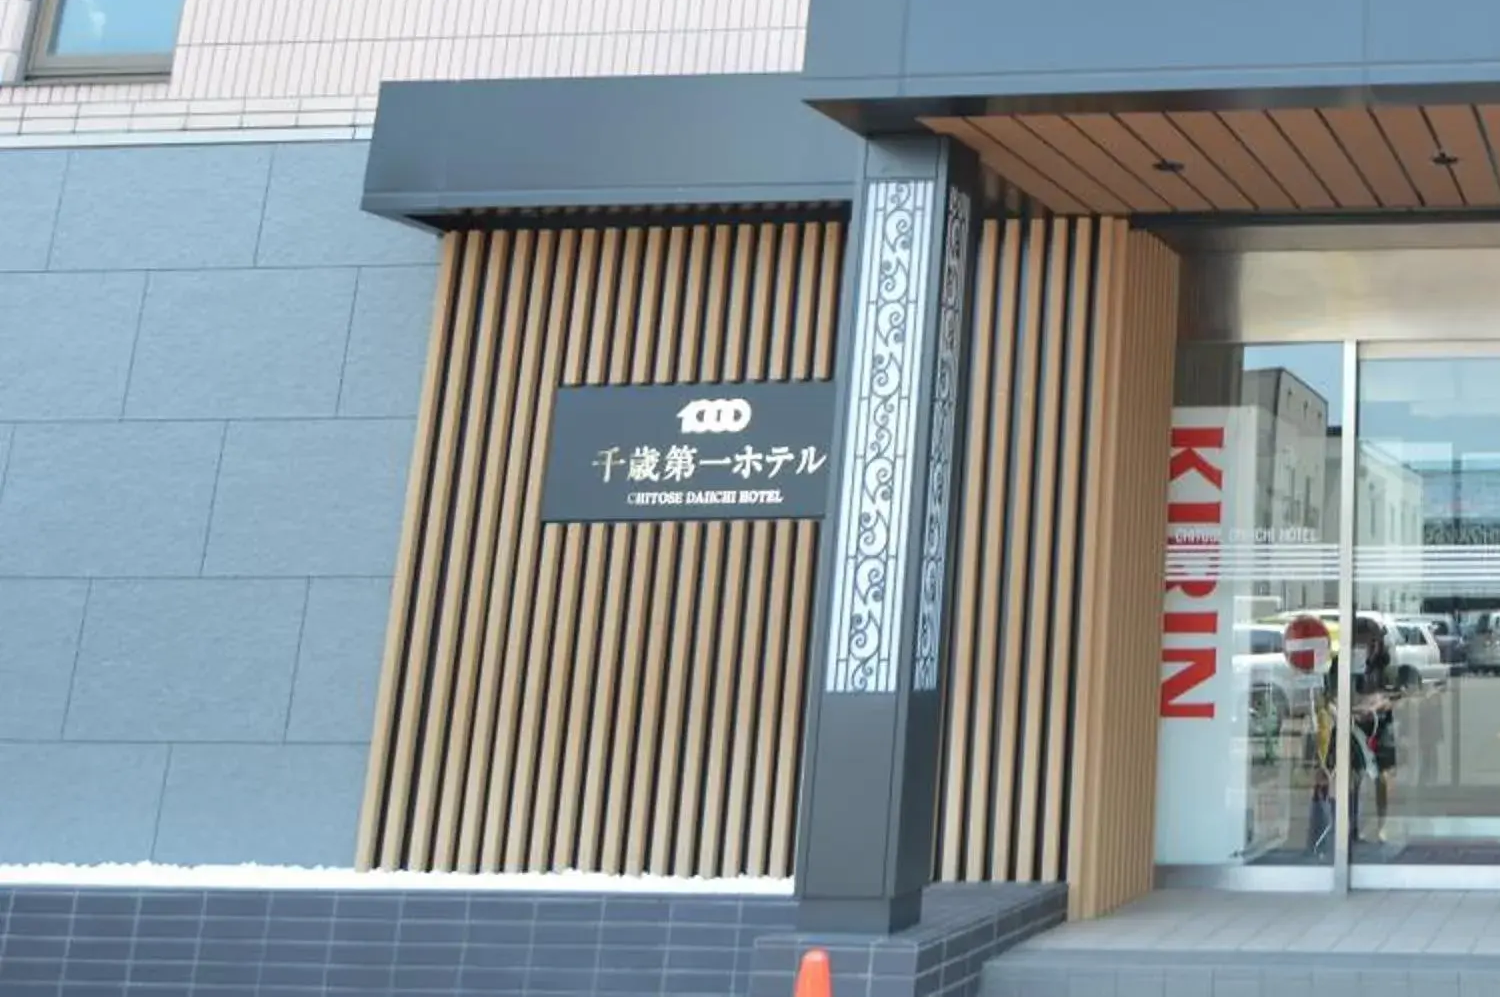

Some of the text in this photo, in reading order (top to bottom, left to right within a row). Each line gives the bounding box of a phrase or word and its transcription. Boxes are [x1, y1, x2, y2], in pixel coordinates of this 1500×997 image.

[591, 444, 828, 484] 千歳第一ホテル
[626, 490, 684, 505] CHITOSE
[738, 488, 785, 503] HOTEL
[1159, 425, 1225, 720] KIRIN
